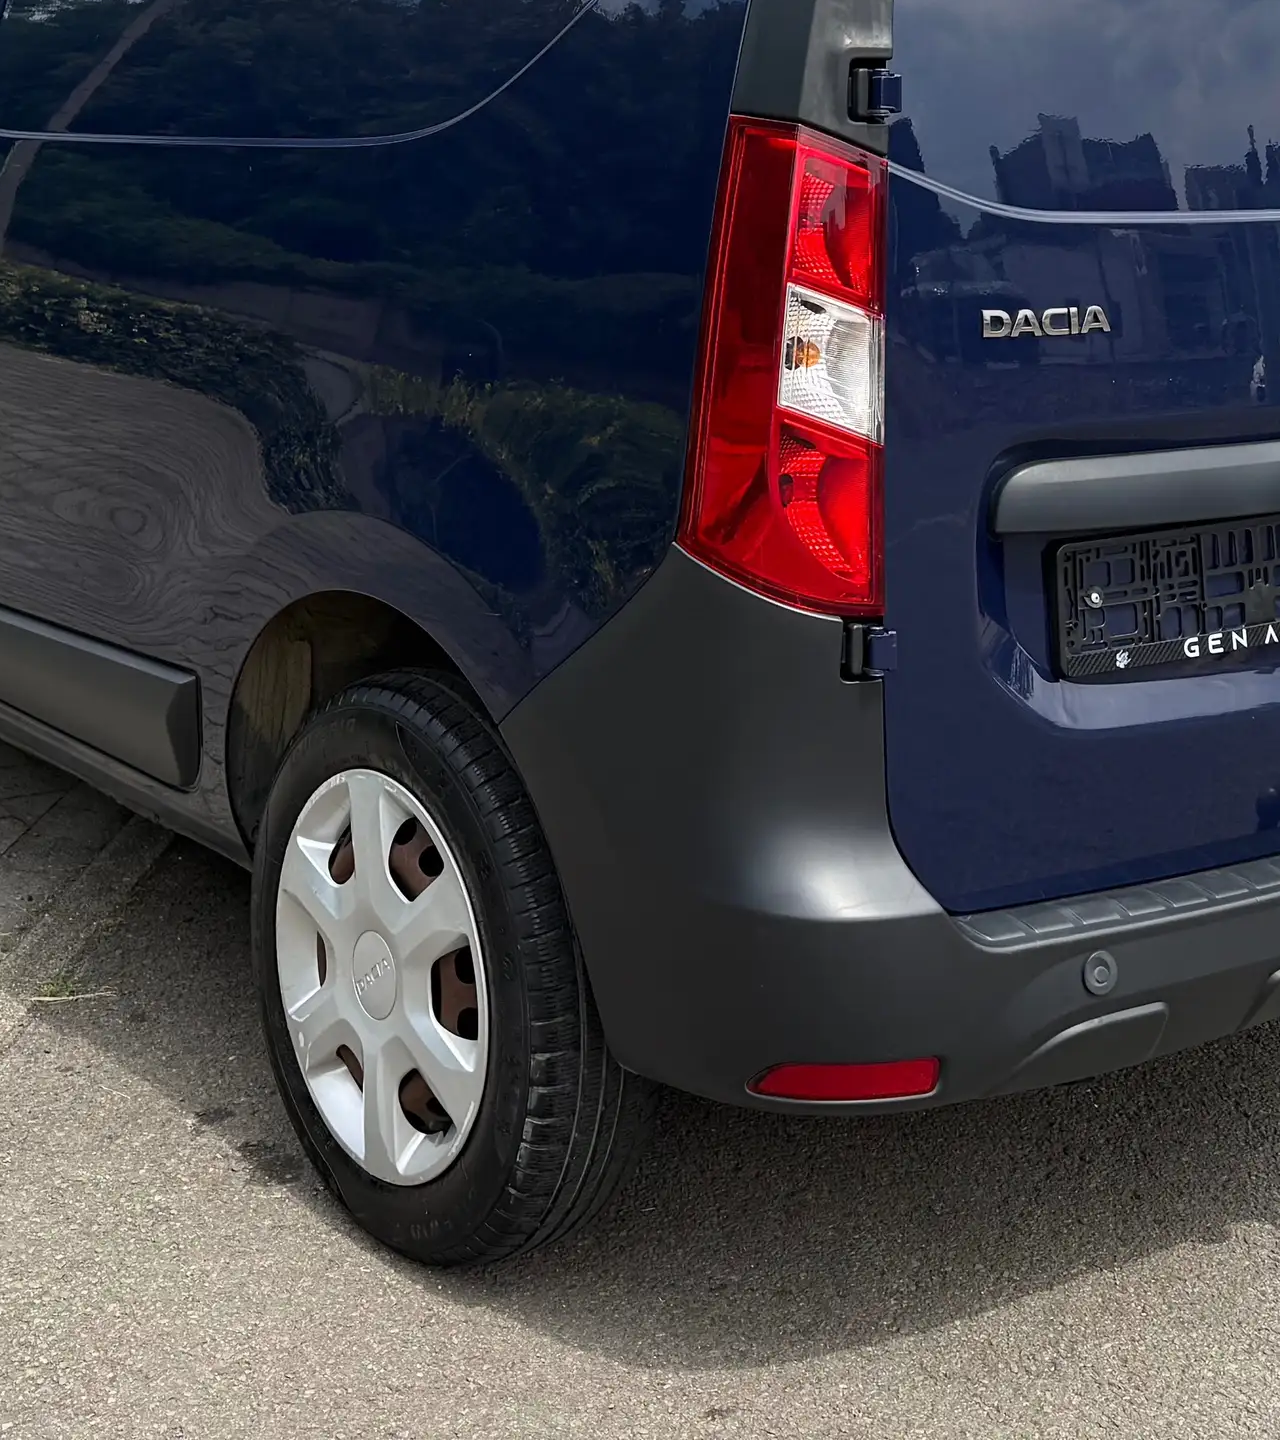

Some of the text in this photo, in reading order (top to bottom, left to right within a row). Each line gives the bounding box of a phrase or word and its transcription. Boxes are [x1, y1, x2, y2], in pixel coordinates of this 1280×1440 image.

[981, 305, 1111, 338] DACIA
[1183, 628, 1248, 658] GEN
[355, 957, 391, 996] DACIA
